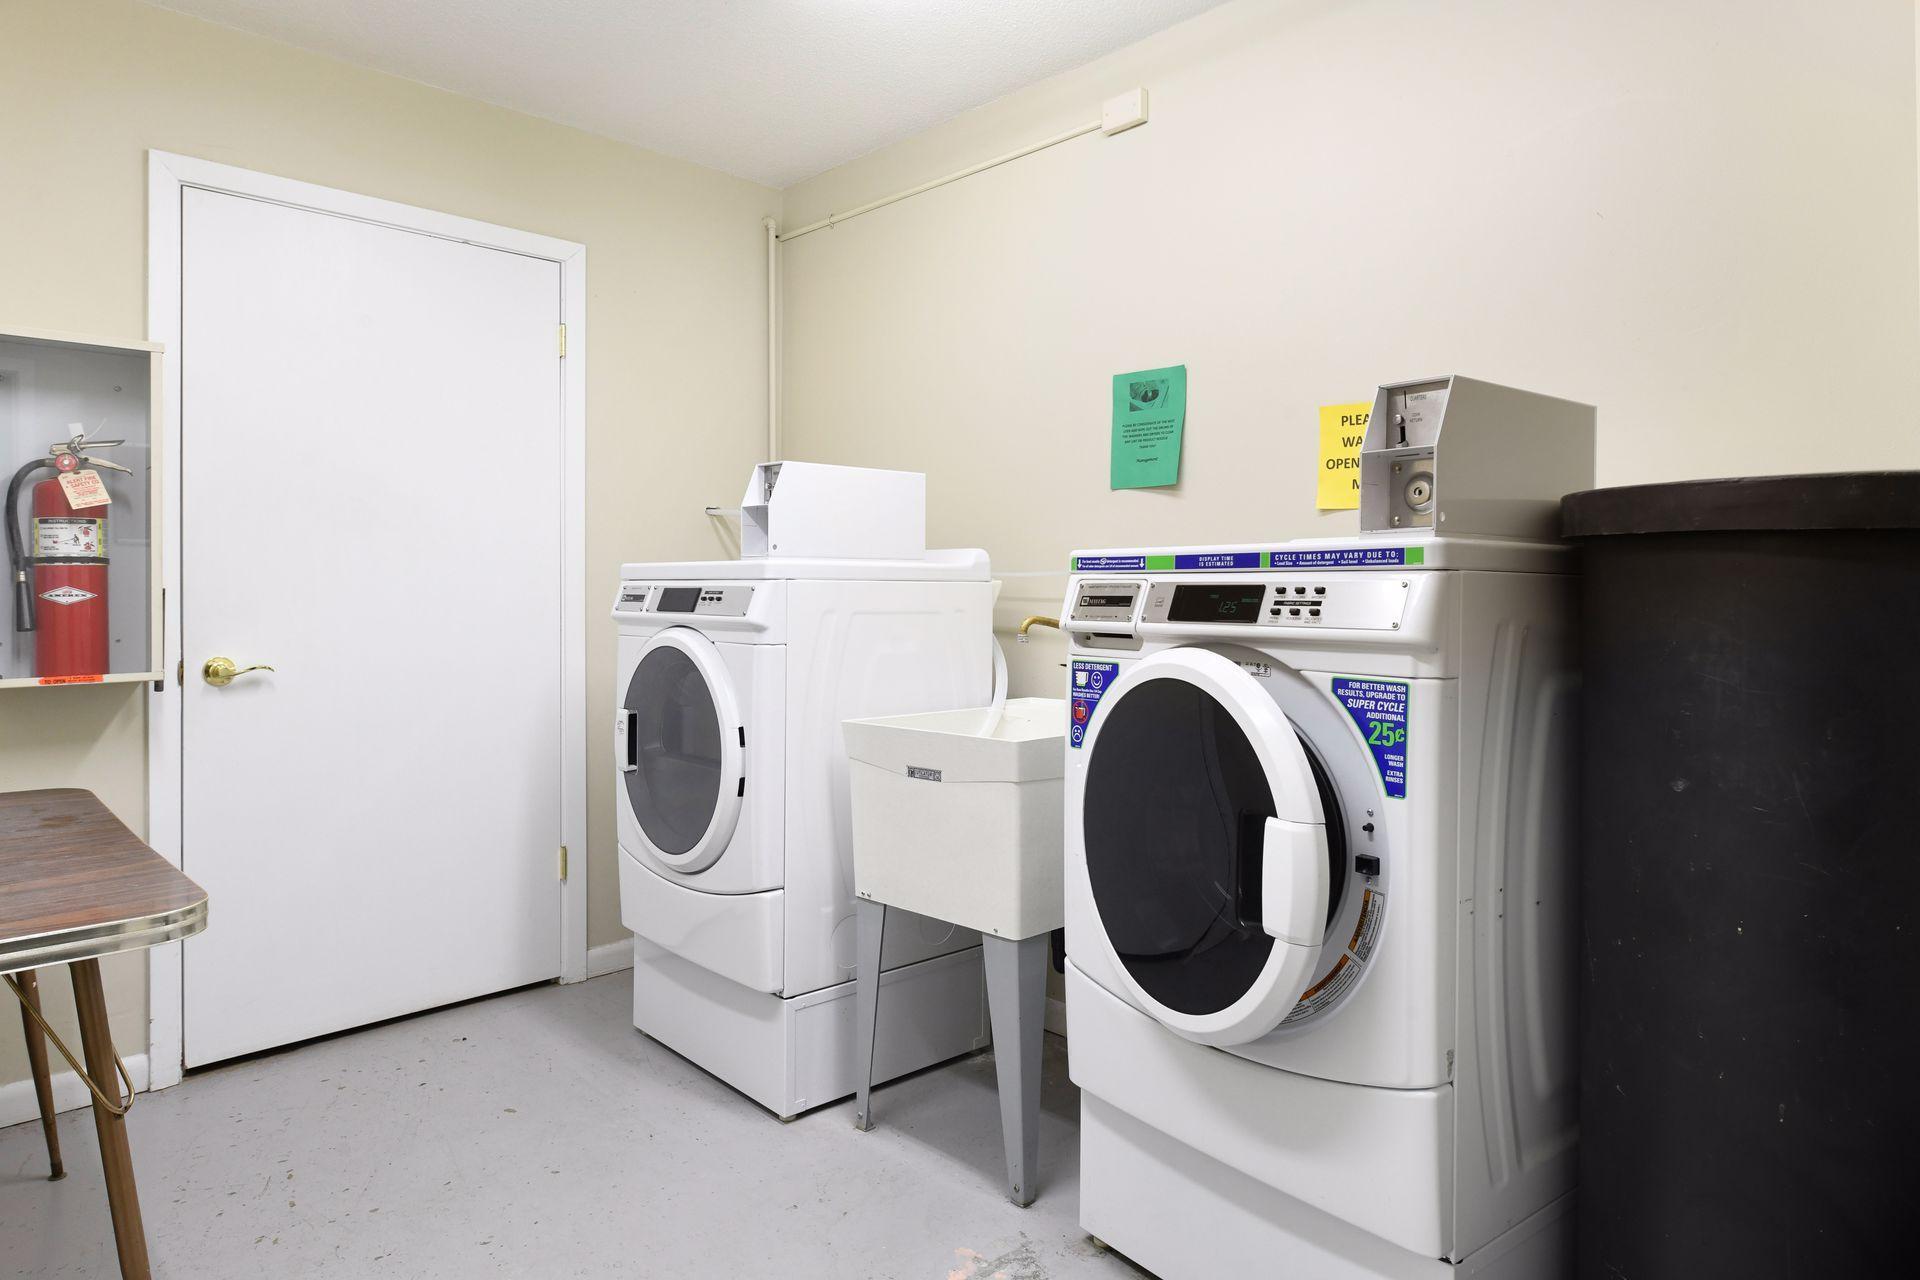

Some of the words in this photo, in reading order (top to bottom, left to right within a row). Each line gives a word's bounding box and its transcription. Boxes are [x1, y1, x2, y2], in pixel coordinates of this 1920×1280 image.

[1326, 458, 1360, 470] OPEN
[1386, 550, 1399, 558] TO:
[1362, 683, 1386, 691] BETTER
[1386, 684, 1406, 692] WASH
[1366, 692, 1396, 700] UPGRADE
[1347, 698, 1375, 710] SUPER
[1377, 702, 1405, 712] CYCLE
[1366, 712, 1405, 722] ADDITIONAL
[1368, 721, 1405, 746] 25¢
[1387, 770, 1404, 778] EXTRA
